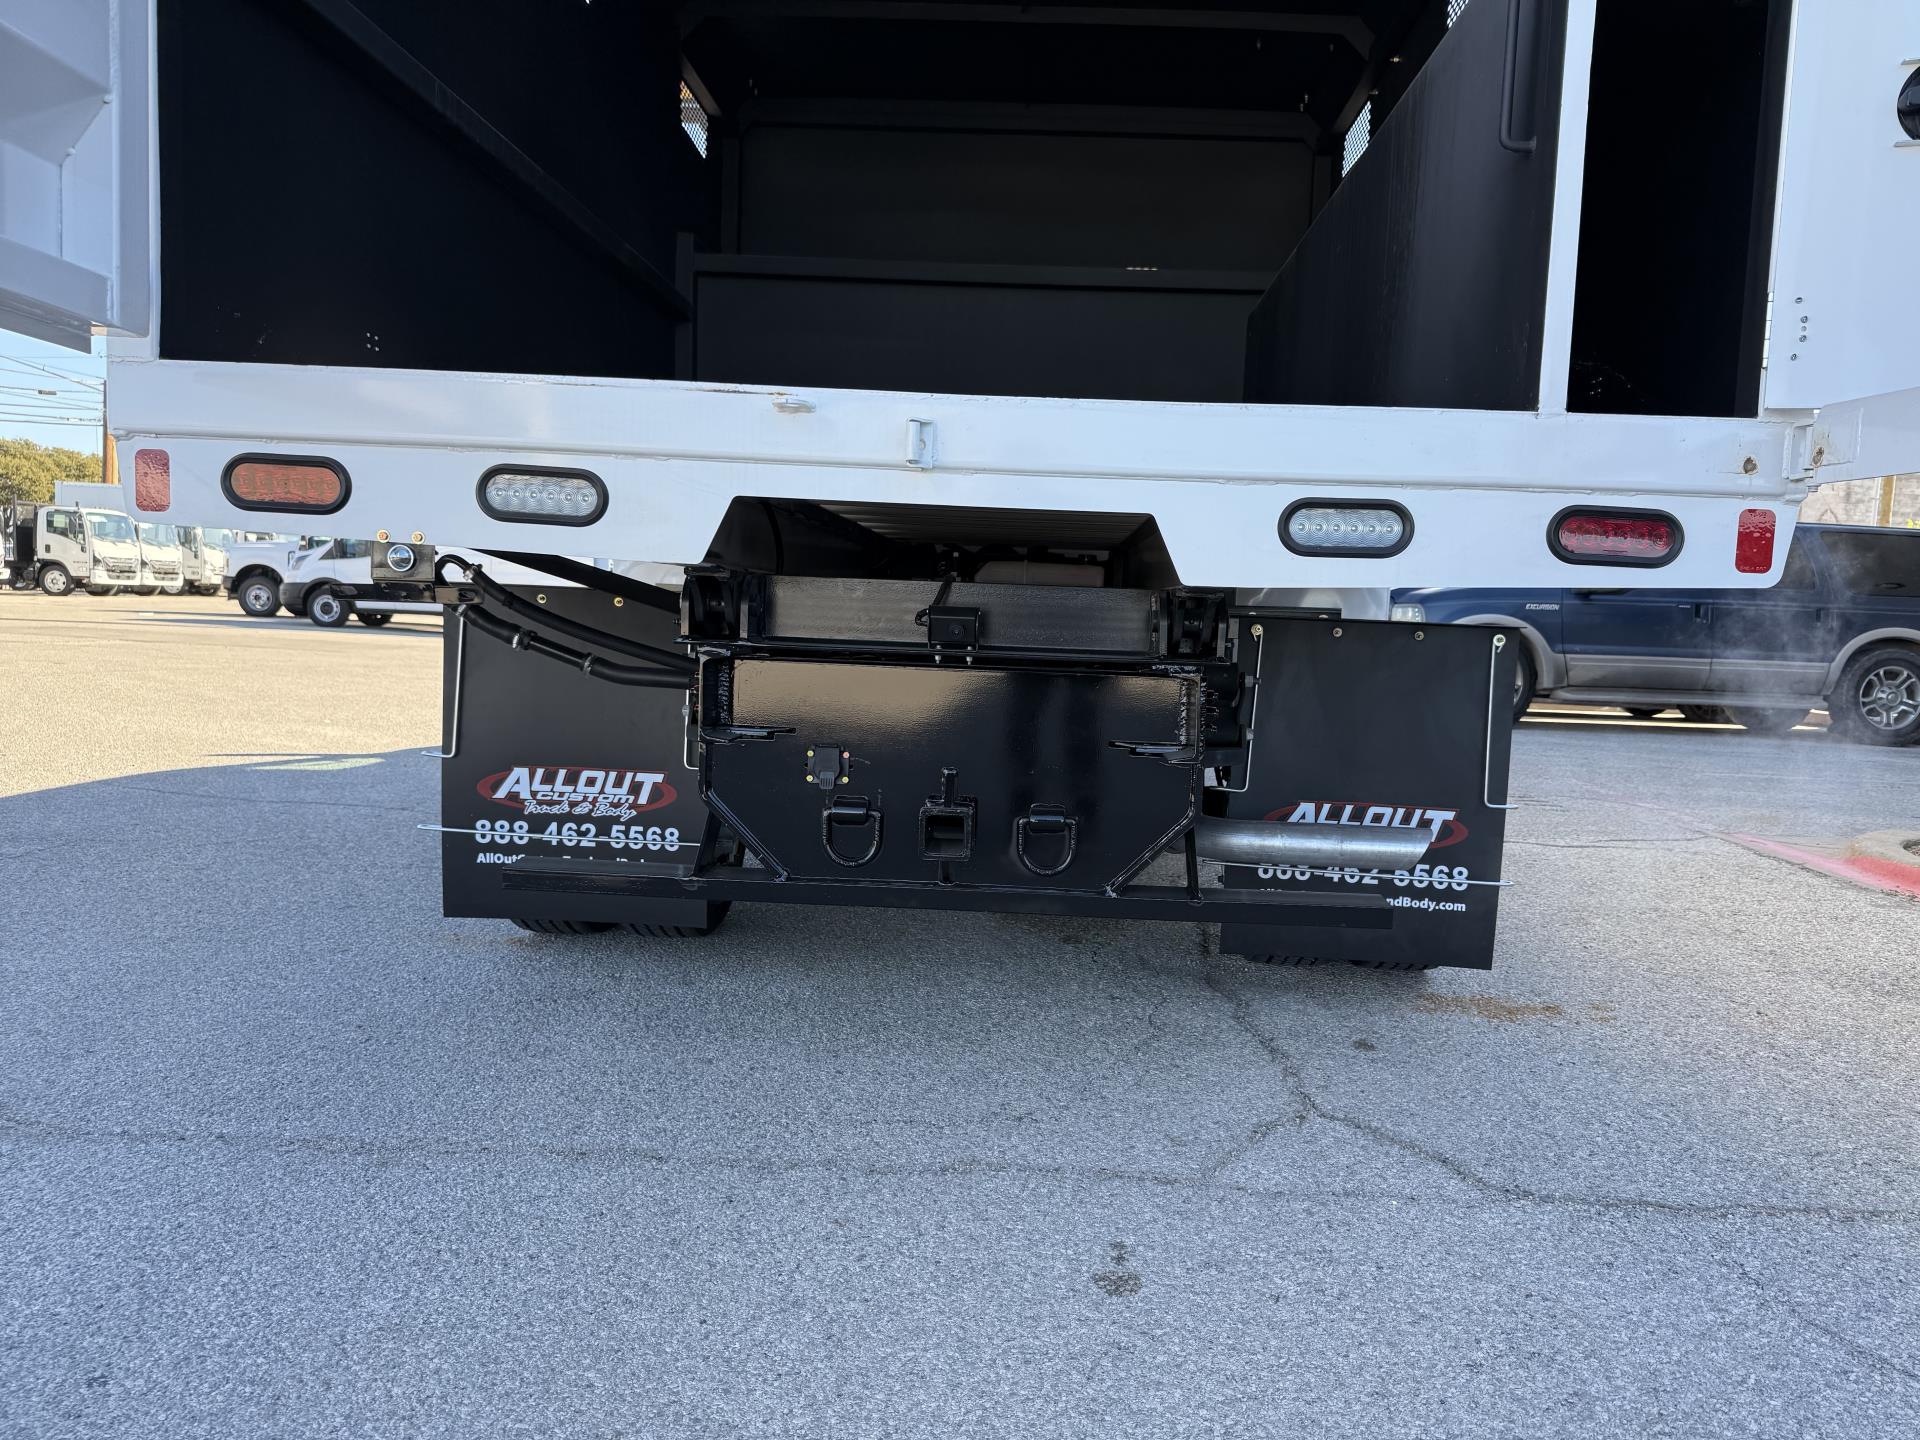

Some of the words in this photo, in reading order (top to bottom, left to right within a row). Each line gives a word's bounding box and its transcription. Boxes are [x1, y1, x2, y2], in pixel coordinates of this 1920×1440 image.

[492, 767, 665, 805] ALLOUT
[536, 791, 635, 804] CUSTOM
[523, 799, 570, 815] Truck
[572, 802, 590, 814] &
[592, 802, 637, 822] Body
